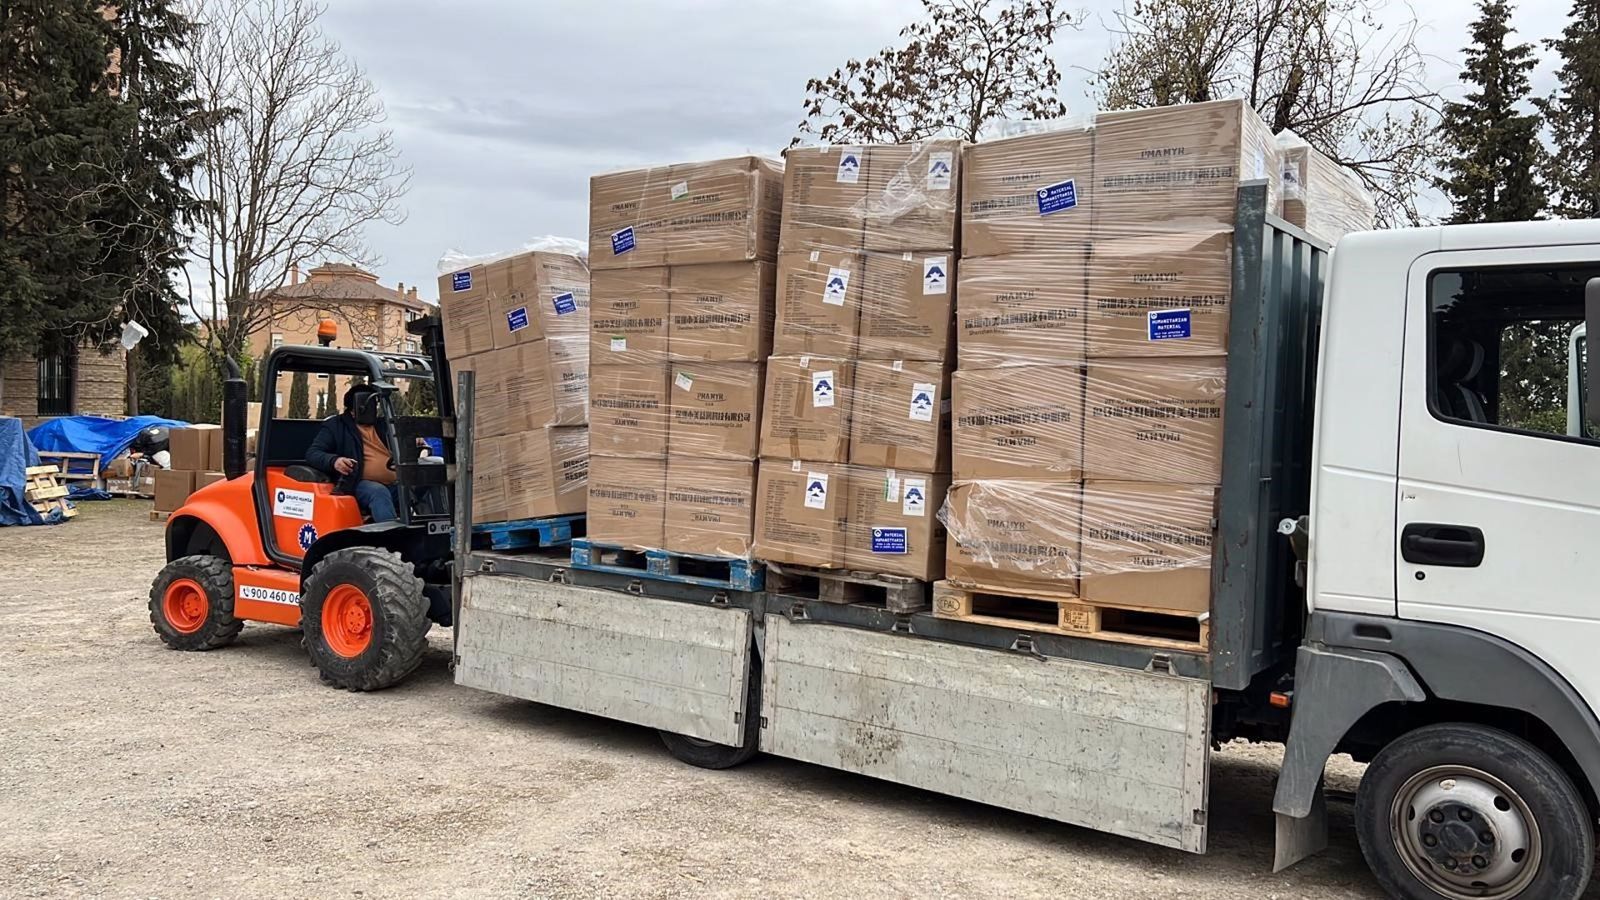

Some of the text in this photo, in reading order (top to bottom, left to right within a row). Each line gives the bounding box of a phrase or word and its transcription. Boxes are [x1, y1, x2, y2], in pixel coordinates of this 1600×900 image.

[1050, 185, 1072, 195] MATERIAL
[303, 531, 312, 544] M
[250, 588, 268, 600] 900
[269, 591, 287, 602] 460
